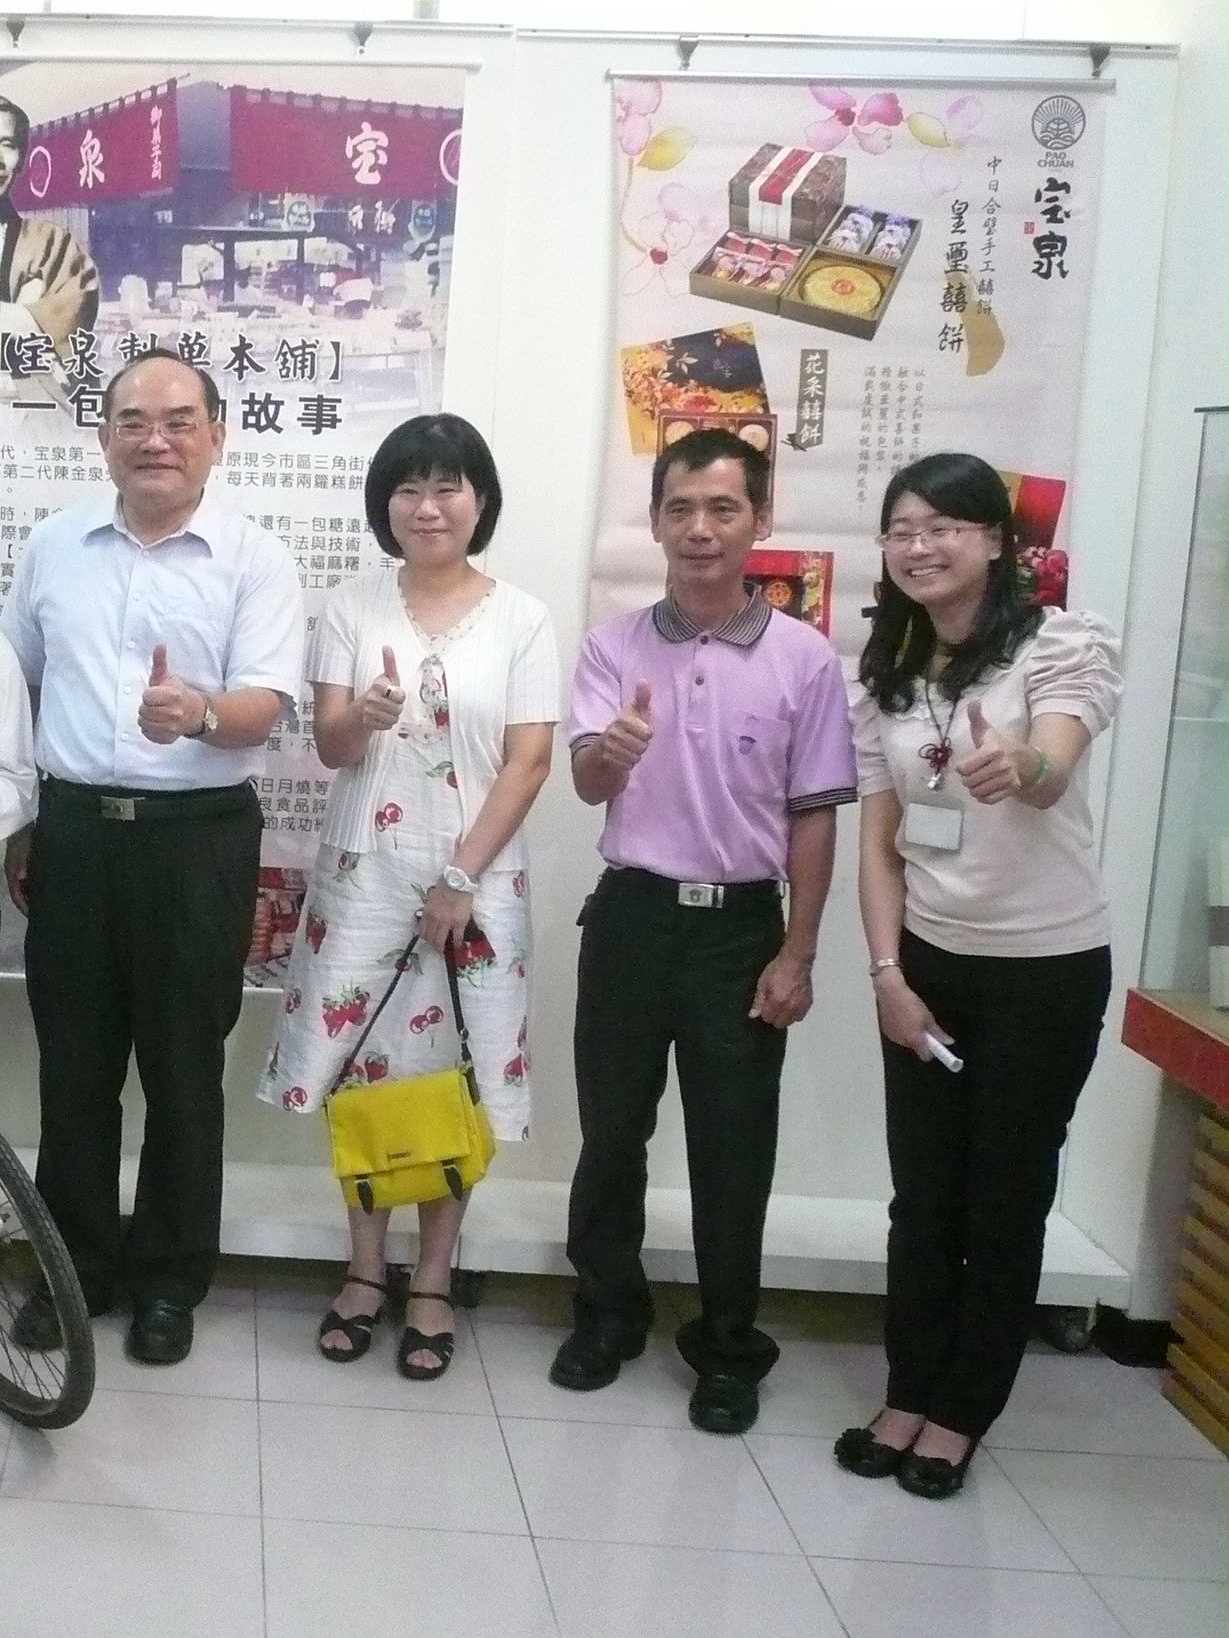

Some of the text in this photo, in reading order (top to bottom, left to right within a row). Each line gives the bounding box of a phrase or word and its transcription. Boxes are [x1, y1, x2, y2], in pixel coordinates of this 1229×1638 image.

[344, 120, 390, 186] 宝
[1045, 151, 1067, 160] PAO
[1037, 159, 1075, 168] CHUAN
